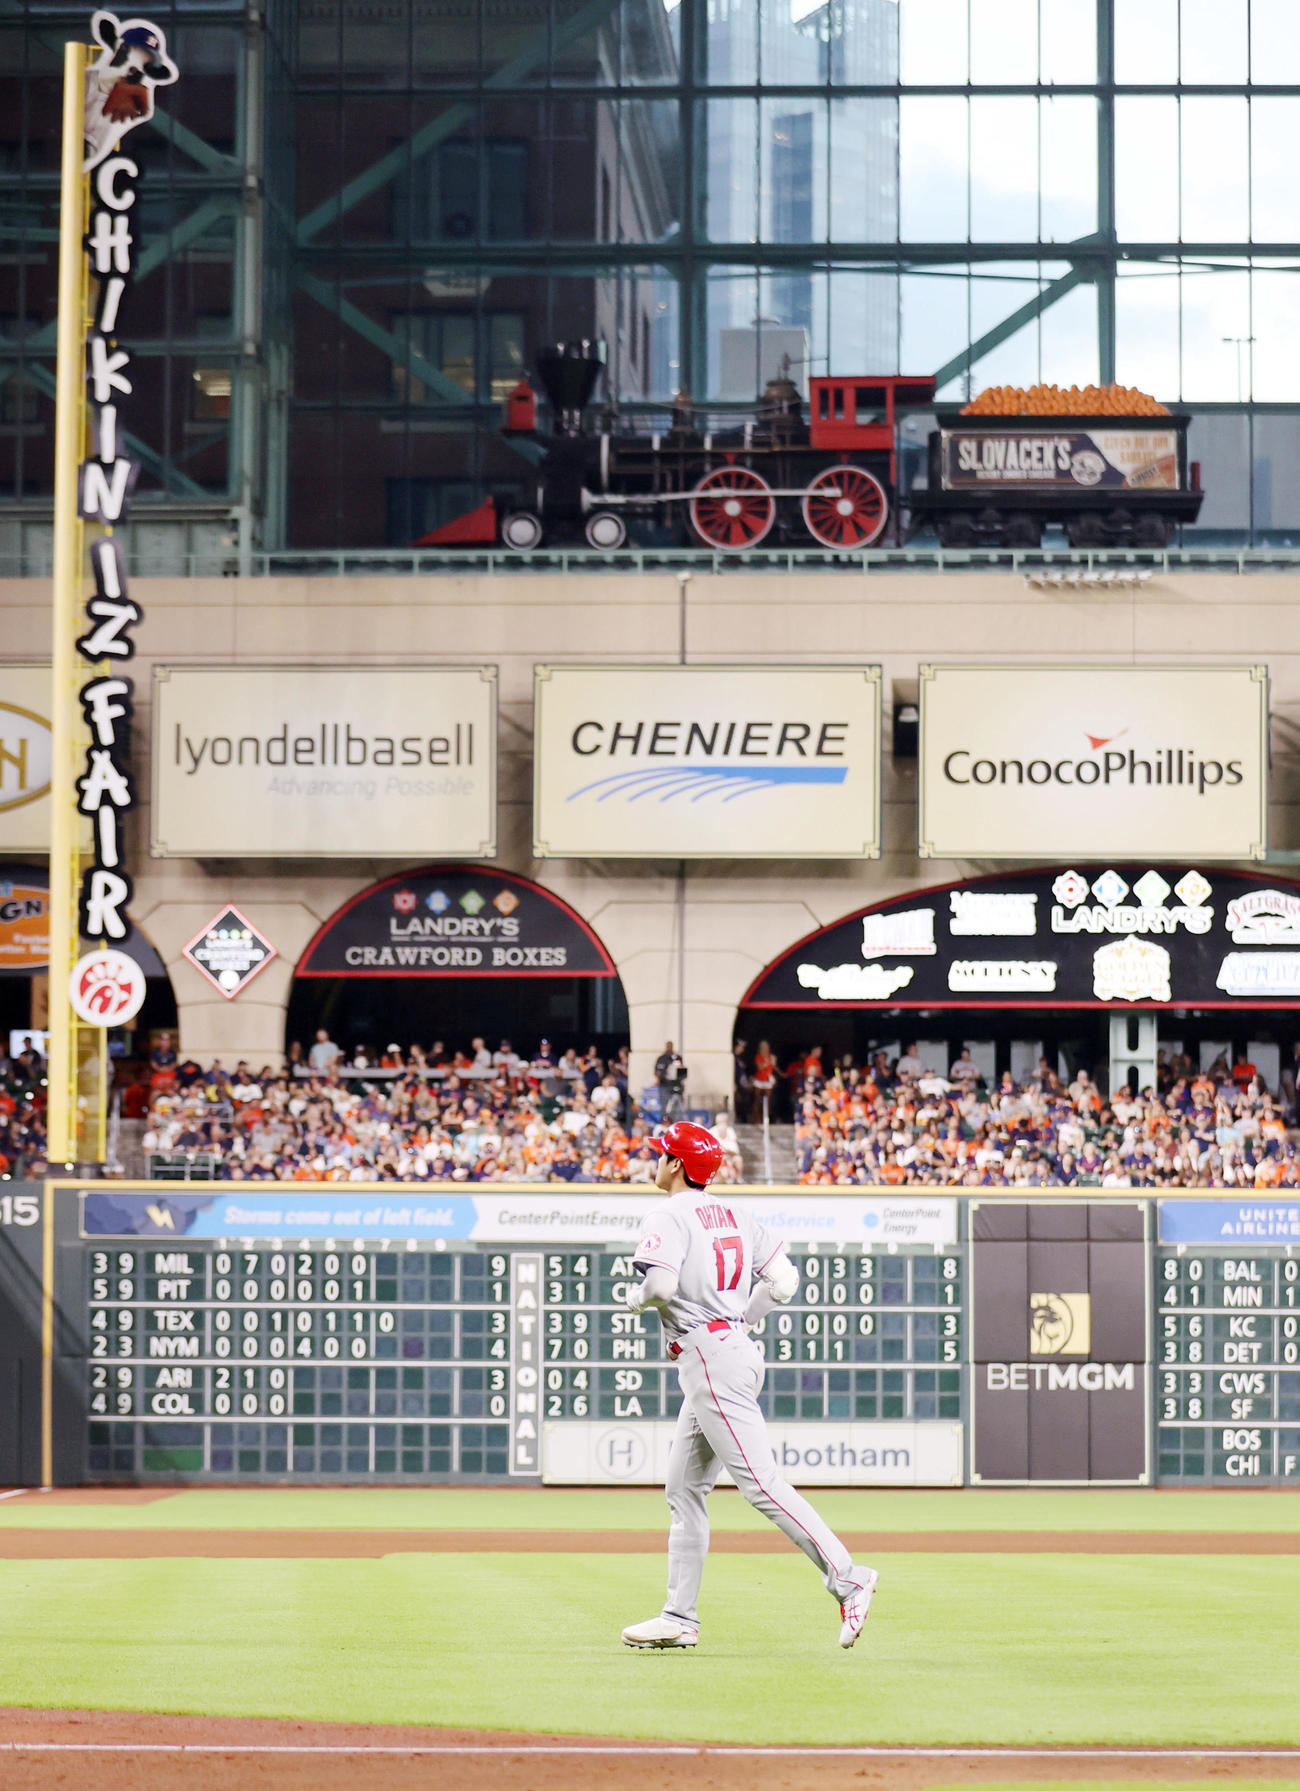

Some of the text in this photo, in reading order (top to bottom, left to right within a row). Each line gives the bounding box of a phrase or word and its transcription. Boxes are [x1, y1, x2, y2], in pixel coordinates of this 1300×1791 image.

[83, 156, 139, 520] CHIKIN
[175, 723, 474, 775] lyondellbasell
[572, 721, 849, 756] CHENIERE
[943, 749, 1243, 795] ConocoPhillips
[266, 776, 474, 800] Advancing Possible
[80, 680, 131, 939] FAIR
[390, 917, 520, 937] LANDRY'S
[1054, 907, 1213, 932] LANDRY'S
[345, 946, 567, 967] CRAWFORD BOXES
[0, 1195, 40, 1226] 15
[224, 1206, 282, 1225] Storms
[285, 1210, 331, 1225] come
[334, 1209, 361, 1225] out
[695, 1204, 738, 1230] OHTAN
[883, 1207, 941, 1219] CenterPoint
[883, 1223, 918, 1235] Energy
[93, 1253, 506, 1277] 3 9 MIL 0 7 0 2 0 0 9
[549, 1255, 647, 1278] 5 4 AT
[712, 1236, 744, 1291] 17
[805, 1257, 957, 1280] 0 3 3 8
[1164, 1259, 1298, 1282] 8 0 BAL 0
[93, 1279, 503, 1302] 5 9 PIT 0 0 0 0 0 1 1
[549, 1281, 639, 1303] 3 1 CI
[805, 1283, 954, 1305] 0 0 0 1
[1163, 1285, 1295, 1308] 4 1 MIN 1
[93, 1310, 505, 1334] 4 9 TEX 0 0 1 0 1 1 0 3
[549, 1312, 647, 1334] 3 9 STL
[778, 1313, 957, 1337] 0 0 0 0 3
[1164, 1315, 1298, 1339] 5 6 KC 0
[93, 1335, 506, 1359] 2 3 NYM 0 0 0 4 0 0 4
[549, 1338, 646, 1360] 7 0 PHI
[778, 1339, 957, 1362] 3 1 1 5
[1164, 1341, 1298, 1364] 3 8 DET 0
[516, 1262, 538, 1466] NATIONAL
[93, 1367, 505, 1391] 2 9 ARI 2 1 0 3
[549, 1369, 643, 1392] 0 4 SD
[986, 1362, 1136, 1391] BETMGM
[1163, 1372, 1266, 1395] 3 3 CWS
[93, 1393, 505, 1417] 4 9 COL 0 0 0 0
[549, 1395, 643, 1417] 2 6 LA
[1163, 1397, 1253, 1420] 3 8 SF
[1222, 1428, 1262, 1452] BOS
[1225, 1454, 1260, 1477] CHI
